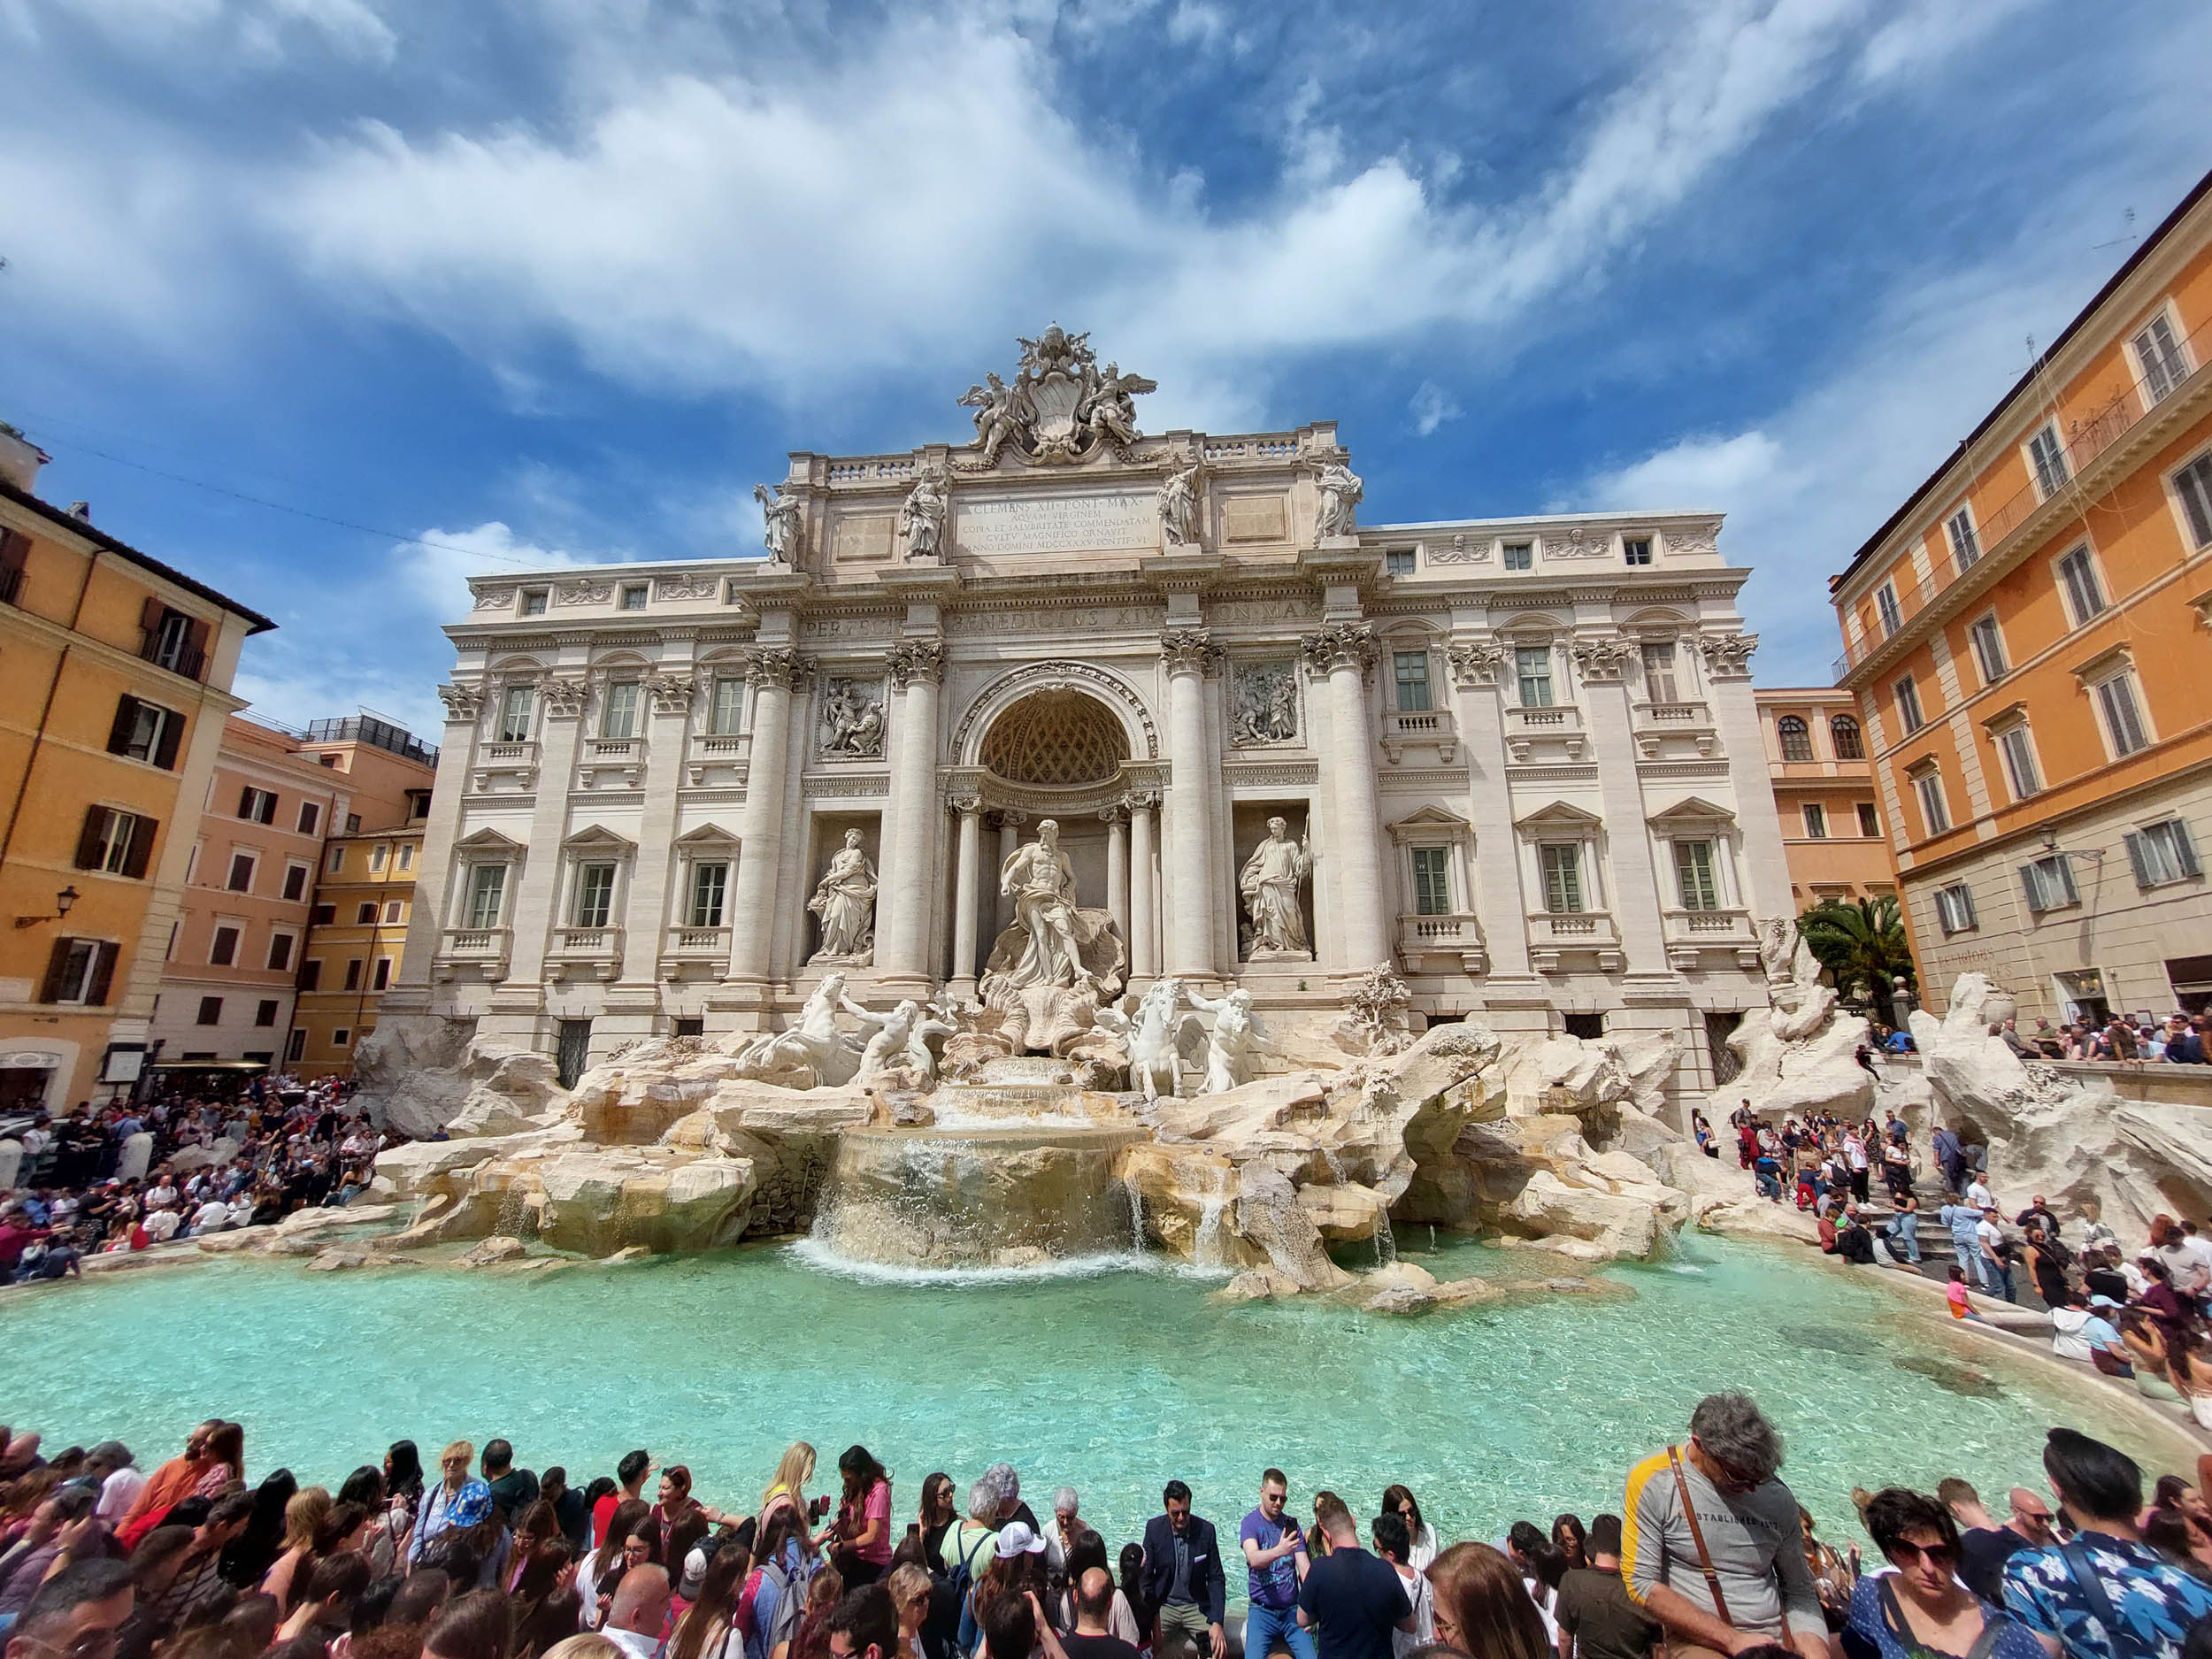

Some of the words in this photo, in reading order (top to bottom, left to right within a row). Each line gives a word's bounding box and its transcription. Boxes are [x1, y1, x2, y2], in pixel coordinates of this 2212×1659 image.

[974, 502, 1030, 513] CLEMENS
[1011, 513, 1046, 522] AQVAM
[1054, 511, 1101, 519] VIRGINEM
[1074, 517, 1150, 528] COMMENDATAM
[987, 533, 1018, 541] CVLTV
[1023, 530, 1078, 540] MAGNIFICO
[1082, 528, 1125, 537] ORNAVIT
[968, 543, 995, 552] ANNO
[1695, 1512, 1756, 1525] STABLISHED
